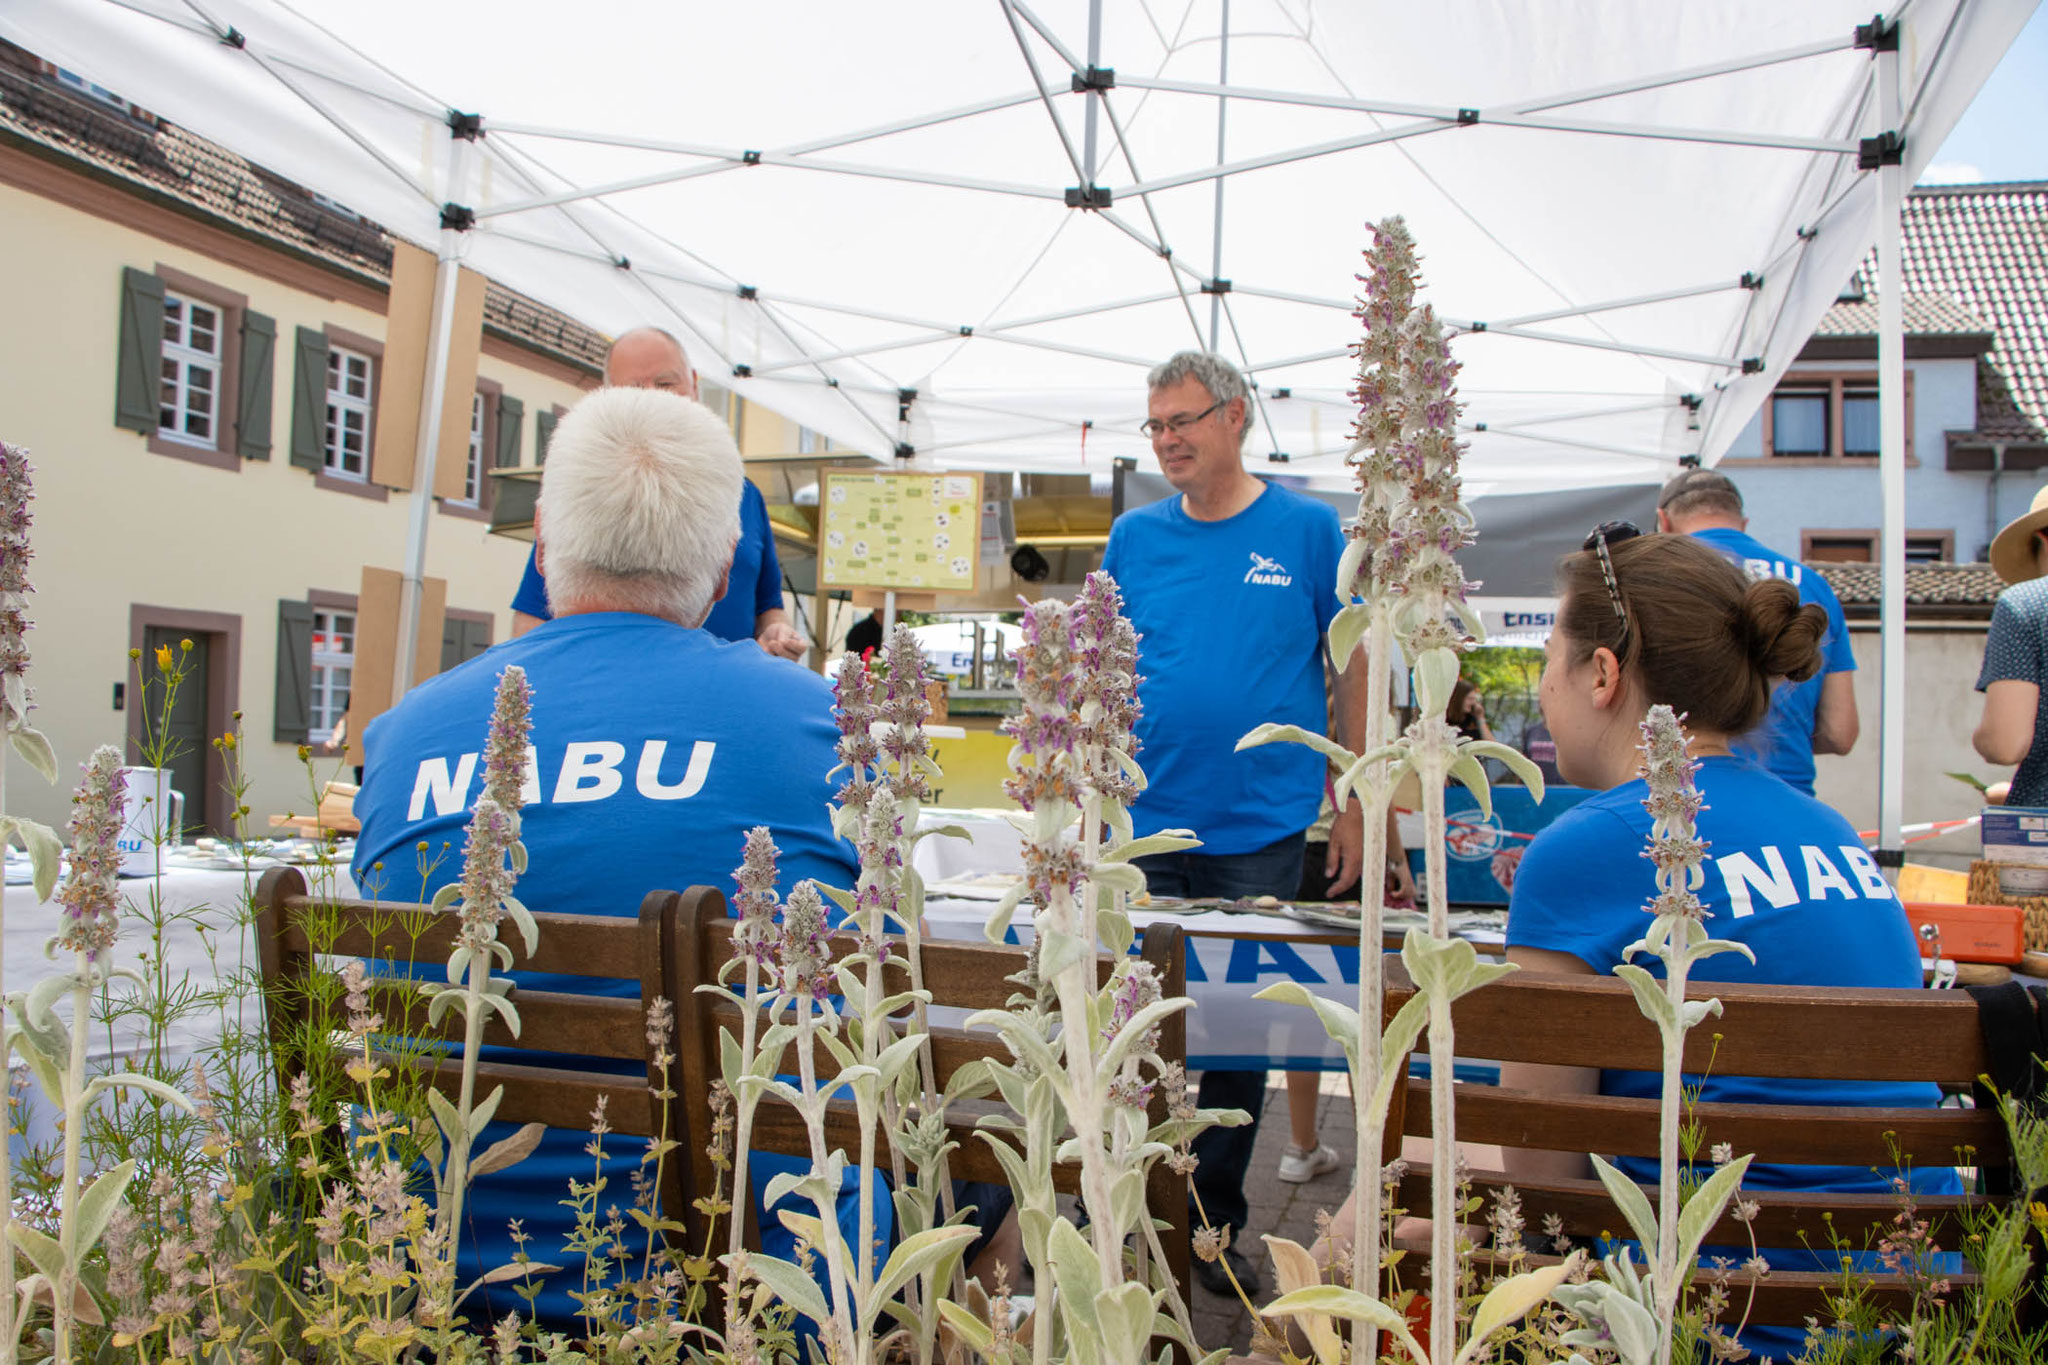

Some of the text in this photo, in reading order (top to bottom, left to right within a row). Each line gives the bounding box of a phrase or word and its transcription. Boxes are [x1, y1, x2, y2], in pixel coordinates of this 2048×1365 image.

[1252, 573, 1292, 586] NABU
[1725, 556, 1802, 588] BU
[1716, 845, 1904, 919] NAB
